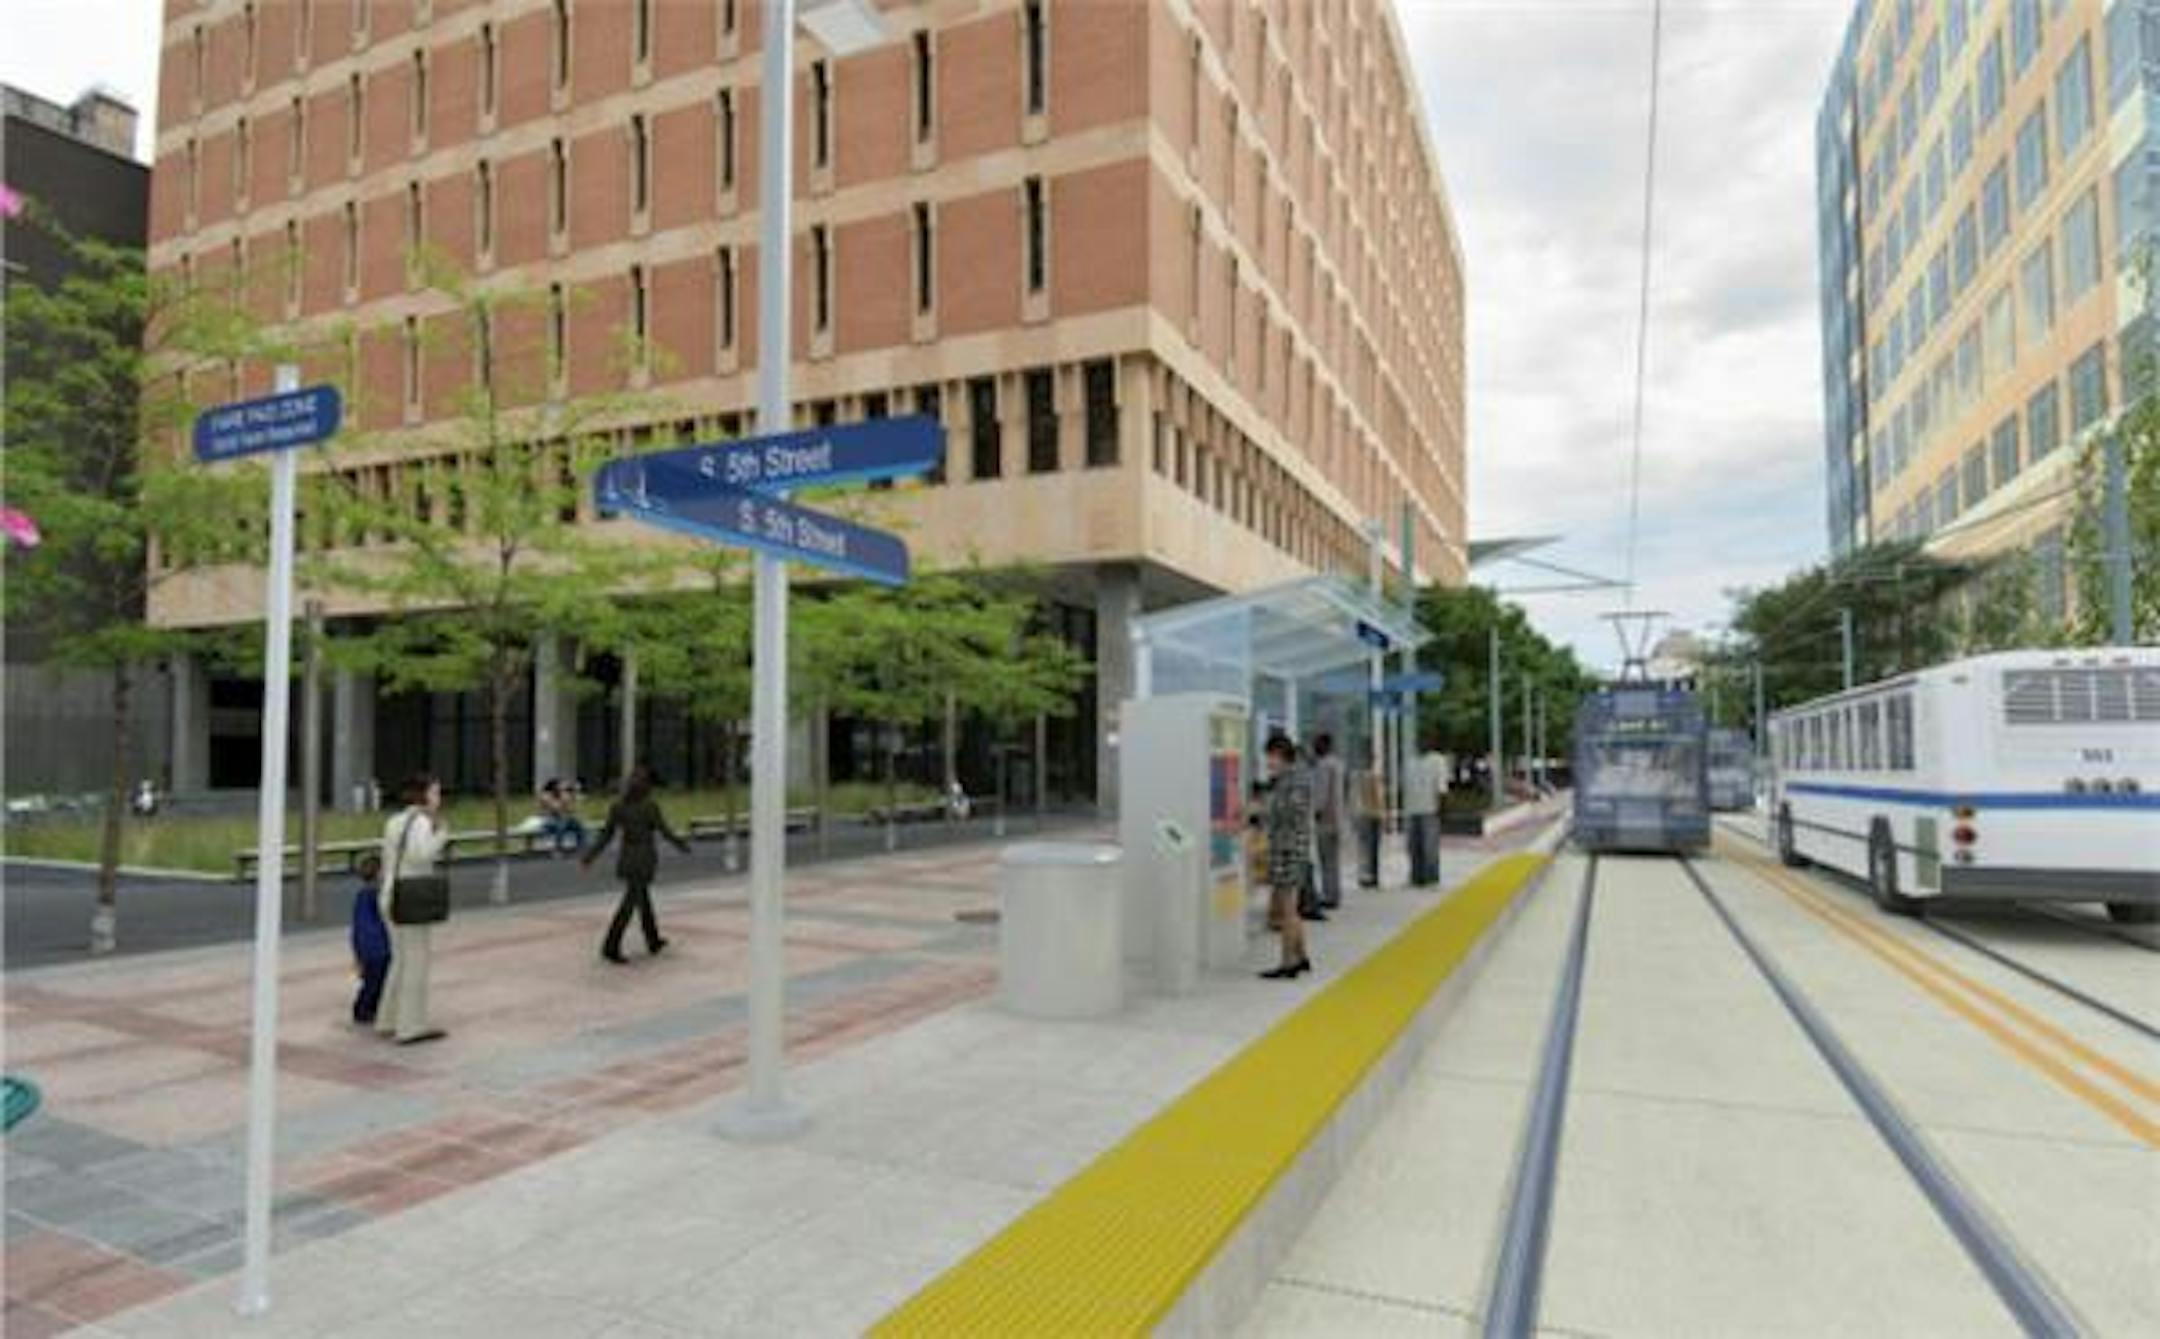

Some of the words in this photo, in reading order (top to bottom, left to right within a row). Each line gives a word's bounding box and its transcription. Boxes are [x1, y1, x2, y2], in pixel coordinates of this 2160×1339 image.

[726, 451, 761, 483] 5th
[765, 441, 832, 477] Street
[798, 516, 846, 556] Street
